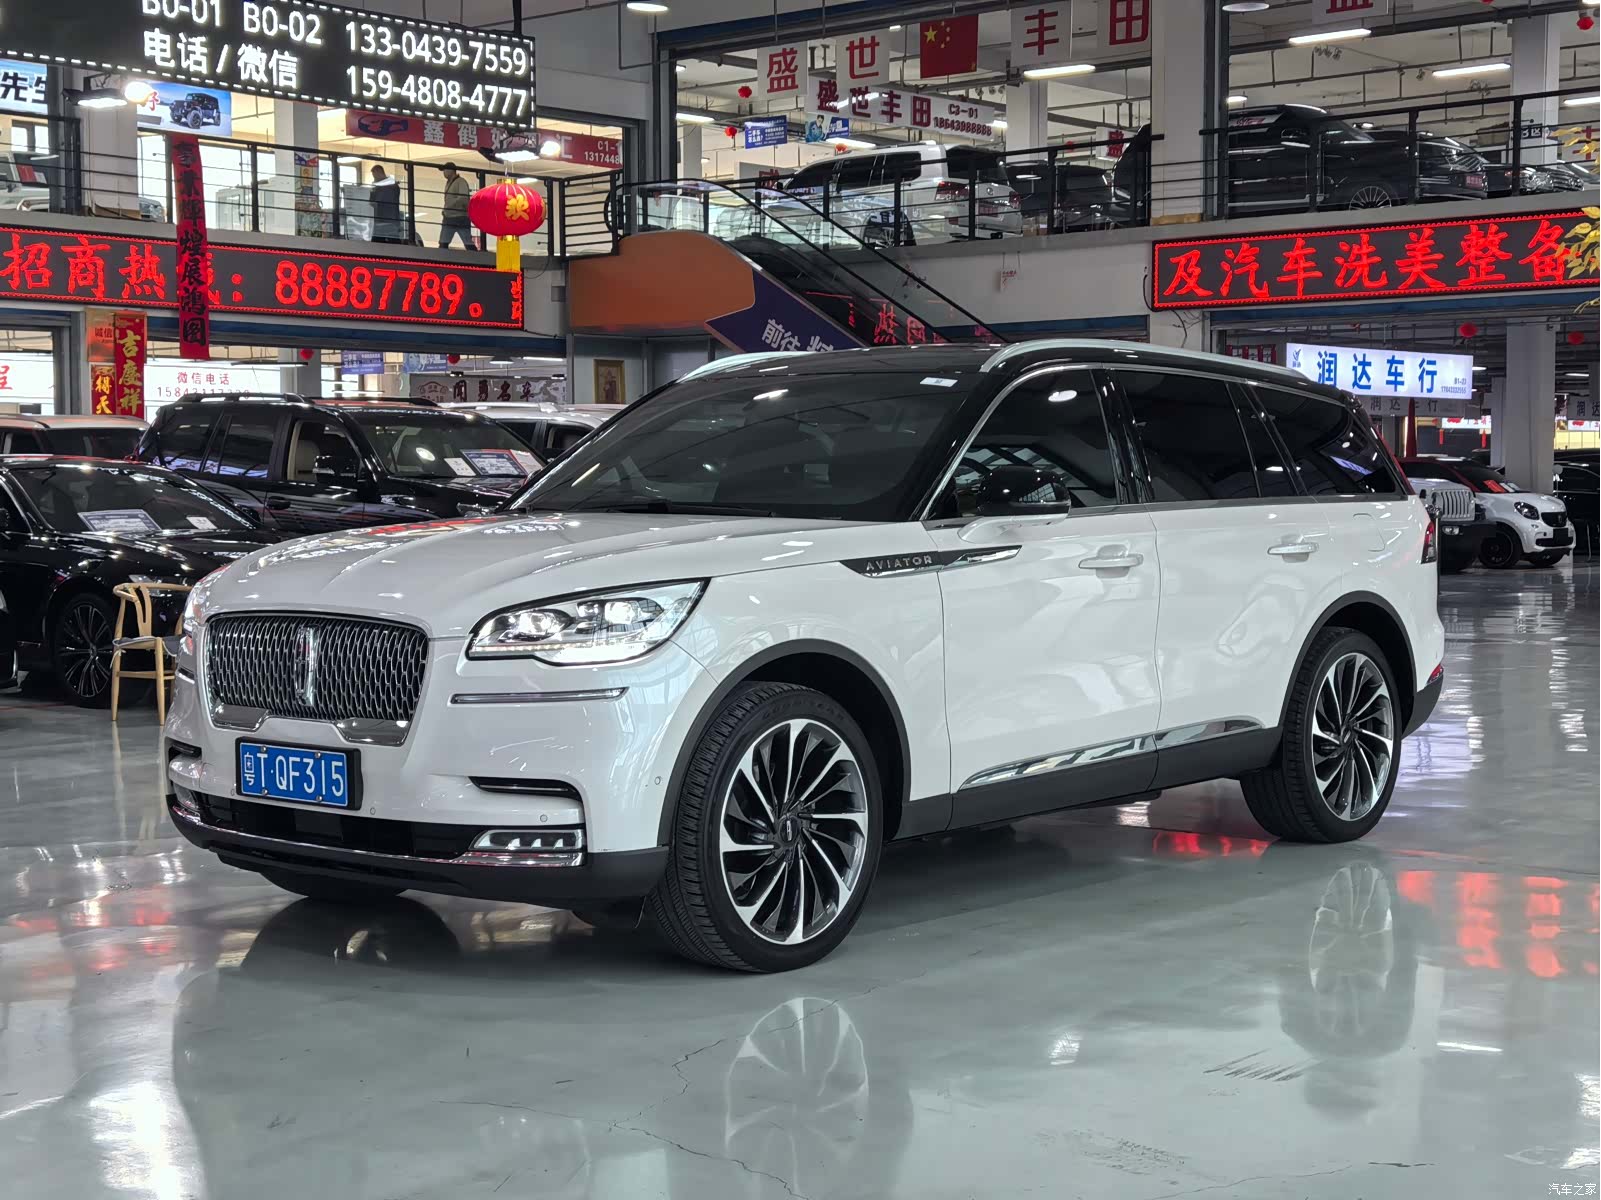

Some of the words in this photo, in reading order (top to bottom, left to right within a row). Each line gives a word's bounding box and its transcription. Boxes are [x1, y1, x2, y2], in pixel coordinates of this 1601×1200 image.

[243, 1, 322, 45] B0-02
[345, 21, 526, 76] 133-0439-7559
[346, 65, 527, 116] 159-4808-4777
[817, 79, 931, 127] 盛世丰田
[177, 371, 231, 385] 微信电话
[1317, 350, 1438, 394] 润达车行
[866, 555, 933, 571] AVIATOR
